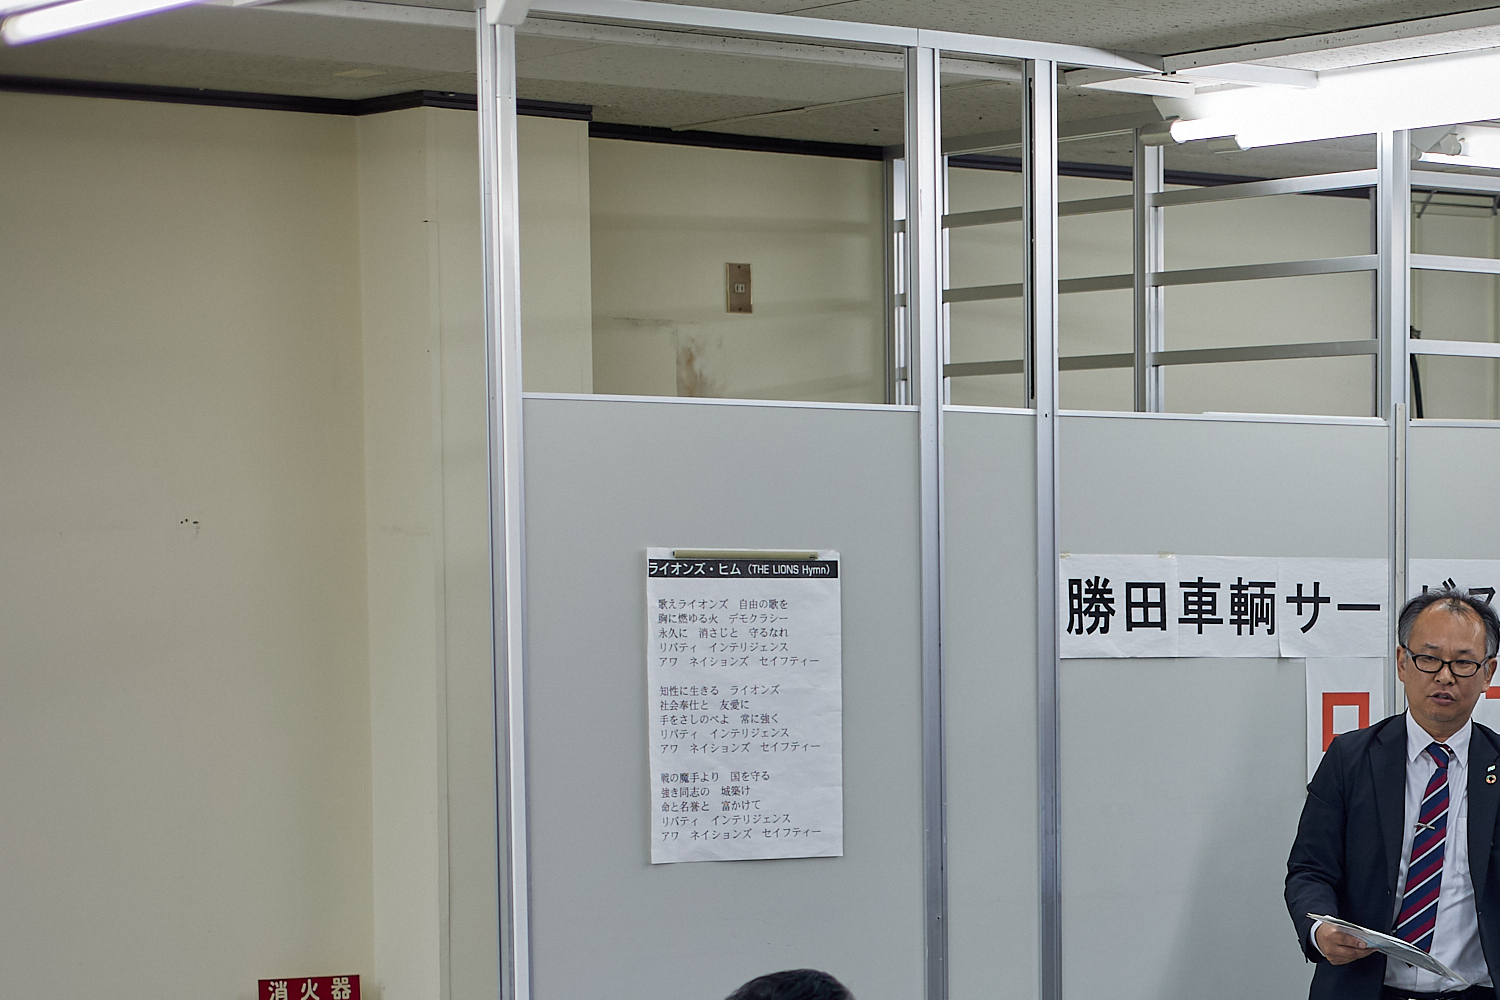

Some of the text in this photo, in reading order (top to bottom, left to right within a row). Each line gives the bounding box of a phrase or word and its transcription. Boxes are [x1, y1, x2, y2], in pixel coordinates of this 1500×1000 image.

[649, 562, 741, 575] ライオンズ・ヒム
[773, 565, 799, 575] LIONS
[658, 599, 788, 610] 歌えライオンズ 自由の歌を
[658, 613, 788, 624] 胸に燃ゆる火 デモクラシー
[658, 627, 788, 638] 永久に 消さじと 守るなれ
[660, 643, 788, 652] リバティ インテリジェンス
[659, 656, 819, 666] アワ ネイションズ セイフティー
[660, 684, 780, 696] 知性に生きる ライオンズ
[660, 700, 749, 711] 社会奉仕と 友愛に
[741, 713, 778, 724] 常に強く
[661, 728, 789, 740] リバティ インテリジェンス
[661, 742, 820, 754] アワ ネイションズ セイフティー
[731, 771, 770, 782] 国を守る
[661, 786, 750, 798] 強き同志の 城築け
[661, 801, 710, 812] 命と名誉と
[662, 814, 791, 827] リバティ インテリジェンス
[662, 828, 821, 841] アワ ネイションズ セイフティー
